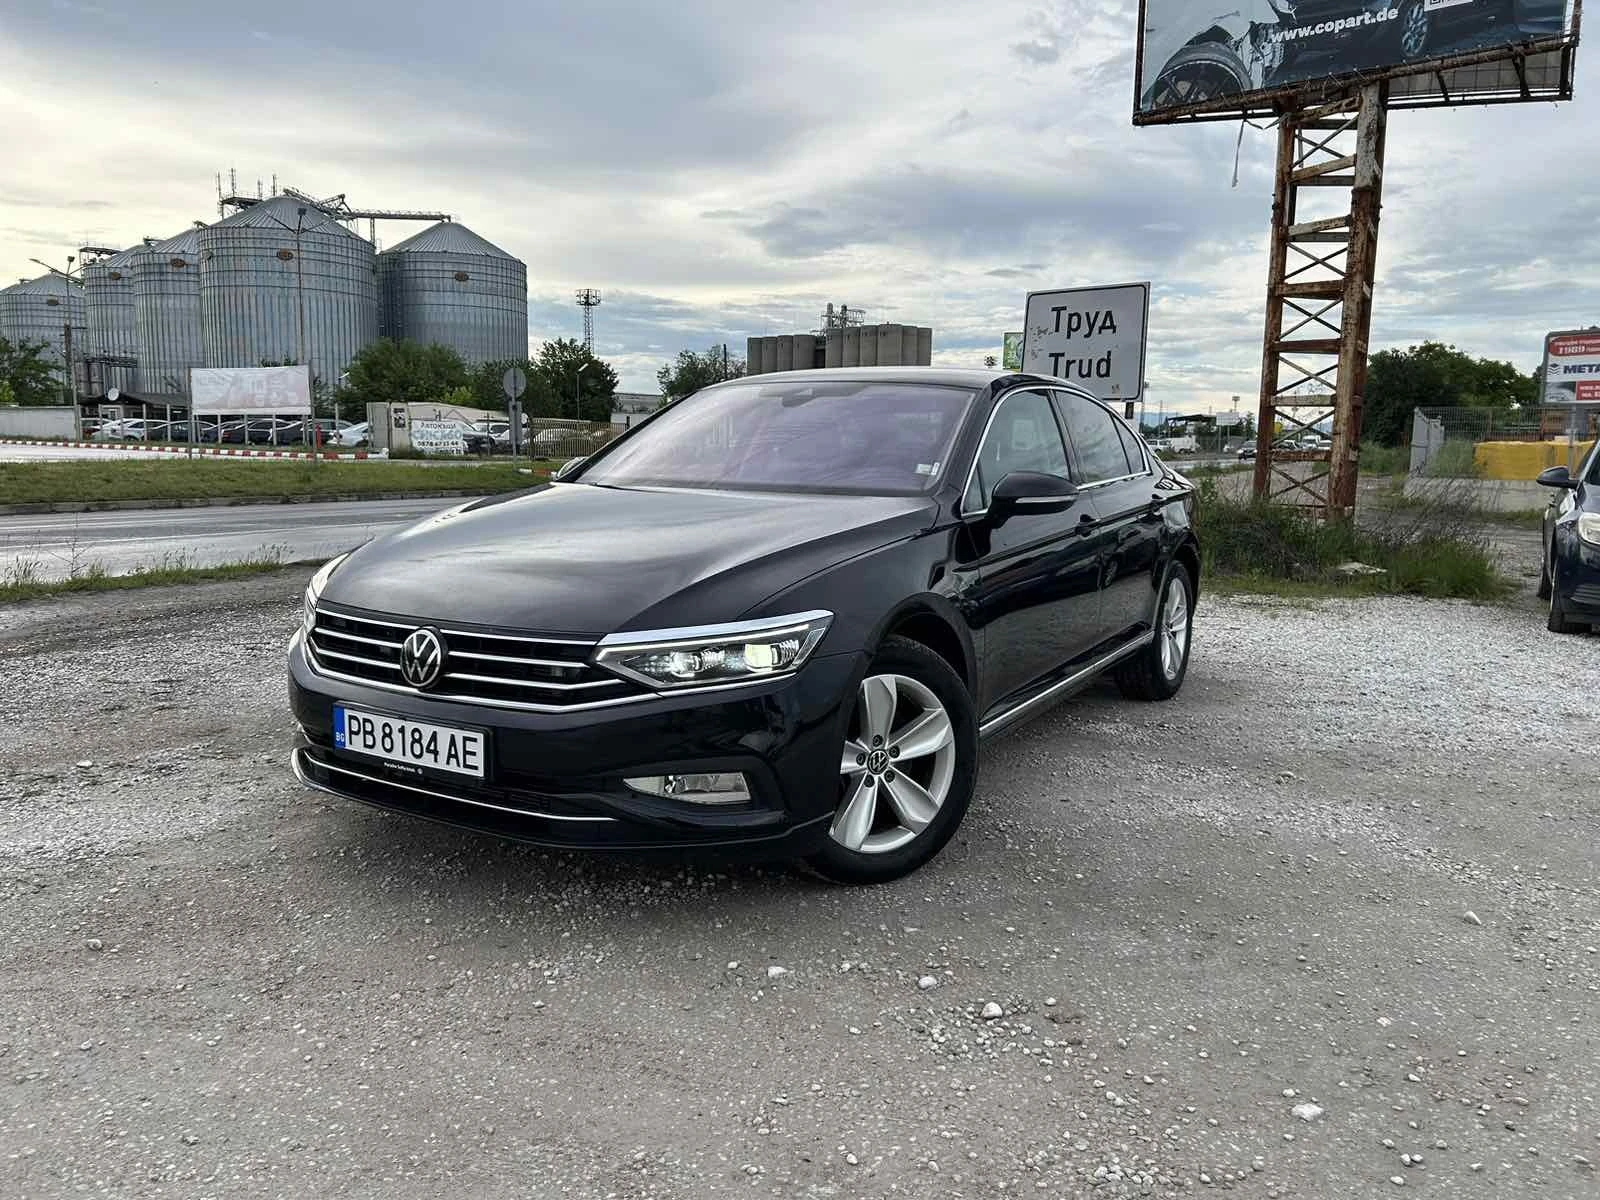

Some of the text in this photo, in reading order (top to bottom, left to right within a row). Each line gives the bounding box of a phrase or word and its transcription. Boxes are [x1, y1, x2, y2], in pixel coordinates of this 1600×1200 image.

[1271, 7, 1399, 43] www.copart.de
[1050, 306, 1117, 339] Труд
[1048, 350, 1112, 379] Trud
[335, 731, 345, 743] BG
[348, 714, 479, 771] PB 8184 AE
